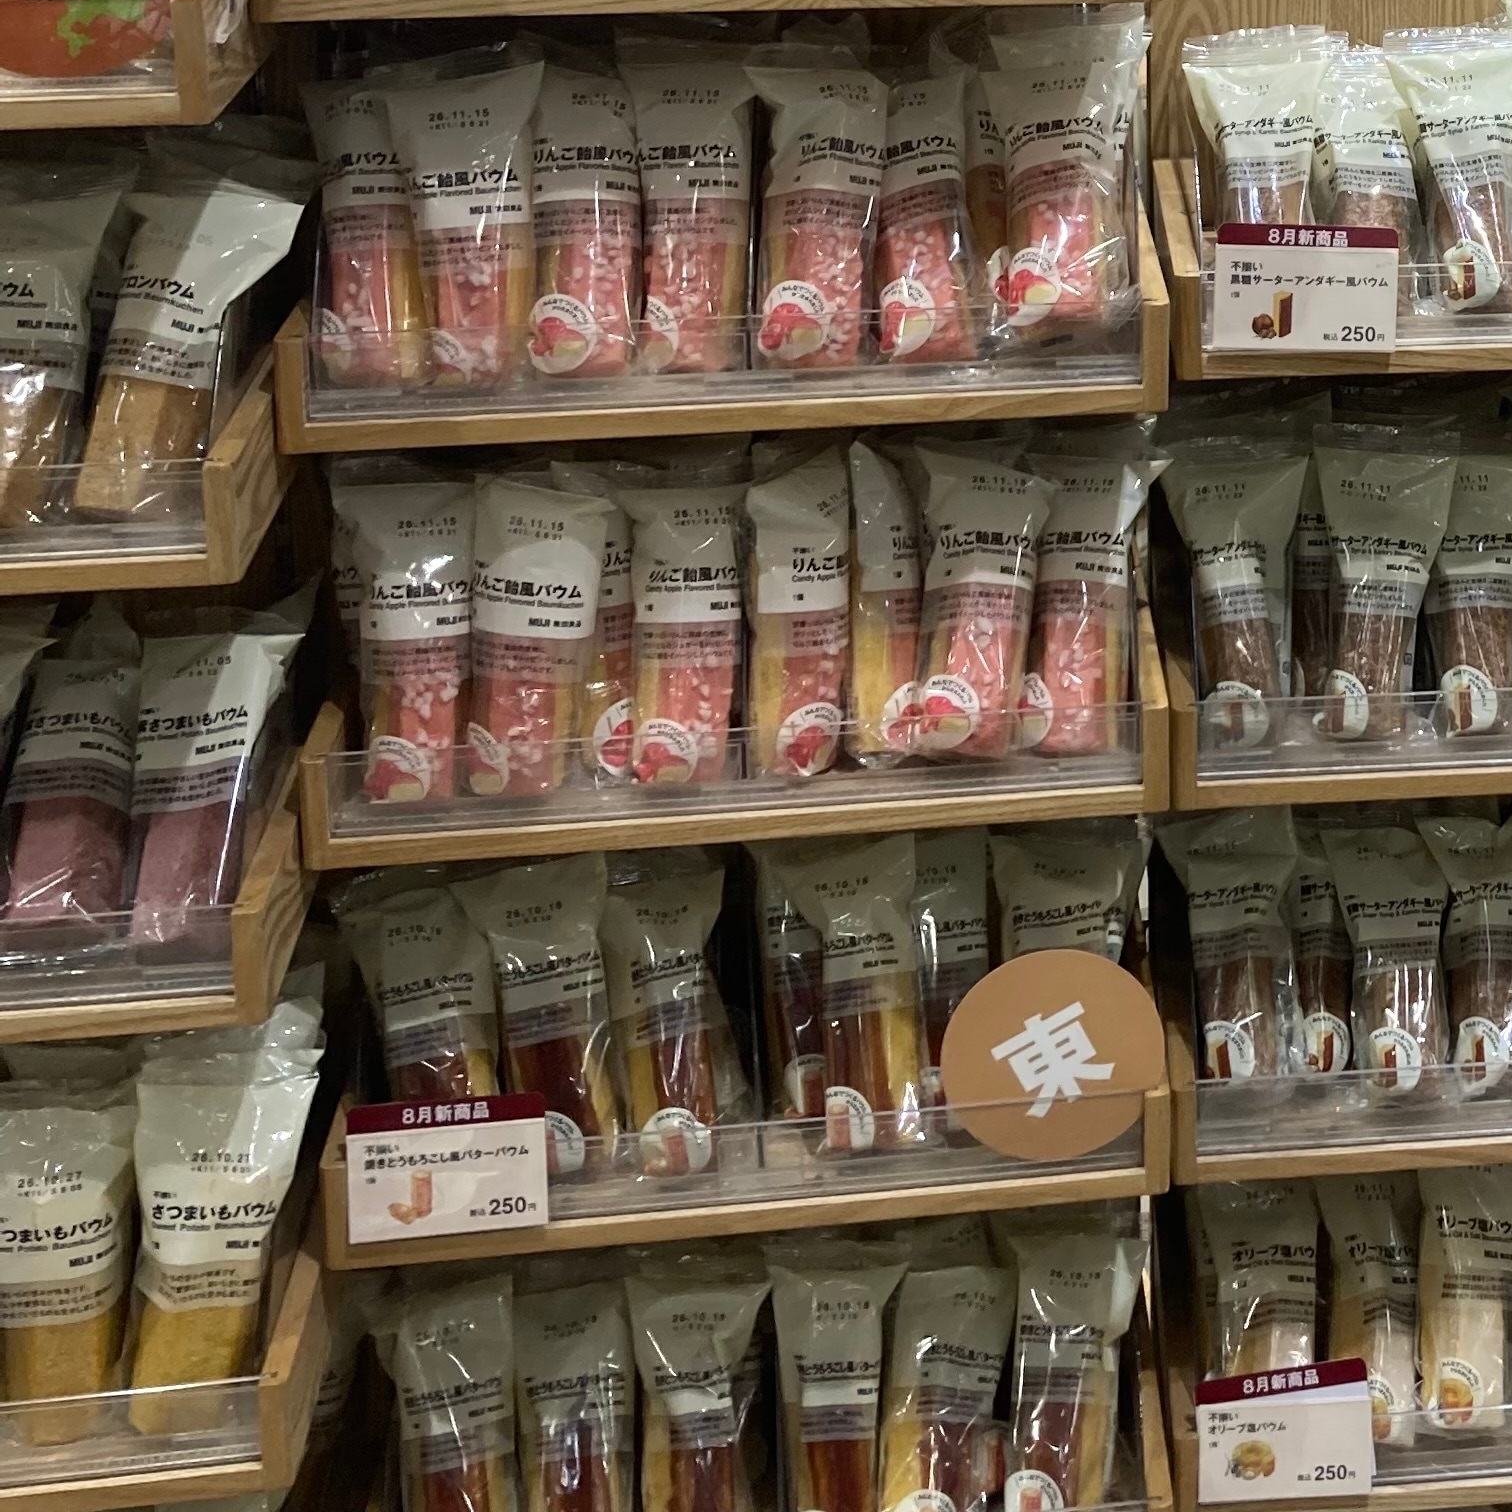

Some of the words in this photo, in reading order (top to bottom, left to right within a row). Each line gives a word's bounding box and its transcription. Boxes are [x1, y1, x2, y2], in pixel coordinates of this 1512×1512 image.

[1268, 229, 1348, 247] 8月新商品
[1230, 274, 1388, 288] 黒糖サーターアンダギー風バウム
[474, 572, 582, 600] りんご飴風バウム
[991, 1001, 1116, 1118] 東
[401, 1101, 490, 1126] 8月新商品
[151, 1202, 278, 1221] さつまいもバウム
[1243, 1369, 1319, 1394] 8月新商品
[1208, 1420, 1287, 1435] オリーブ塩バウム
